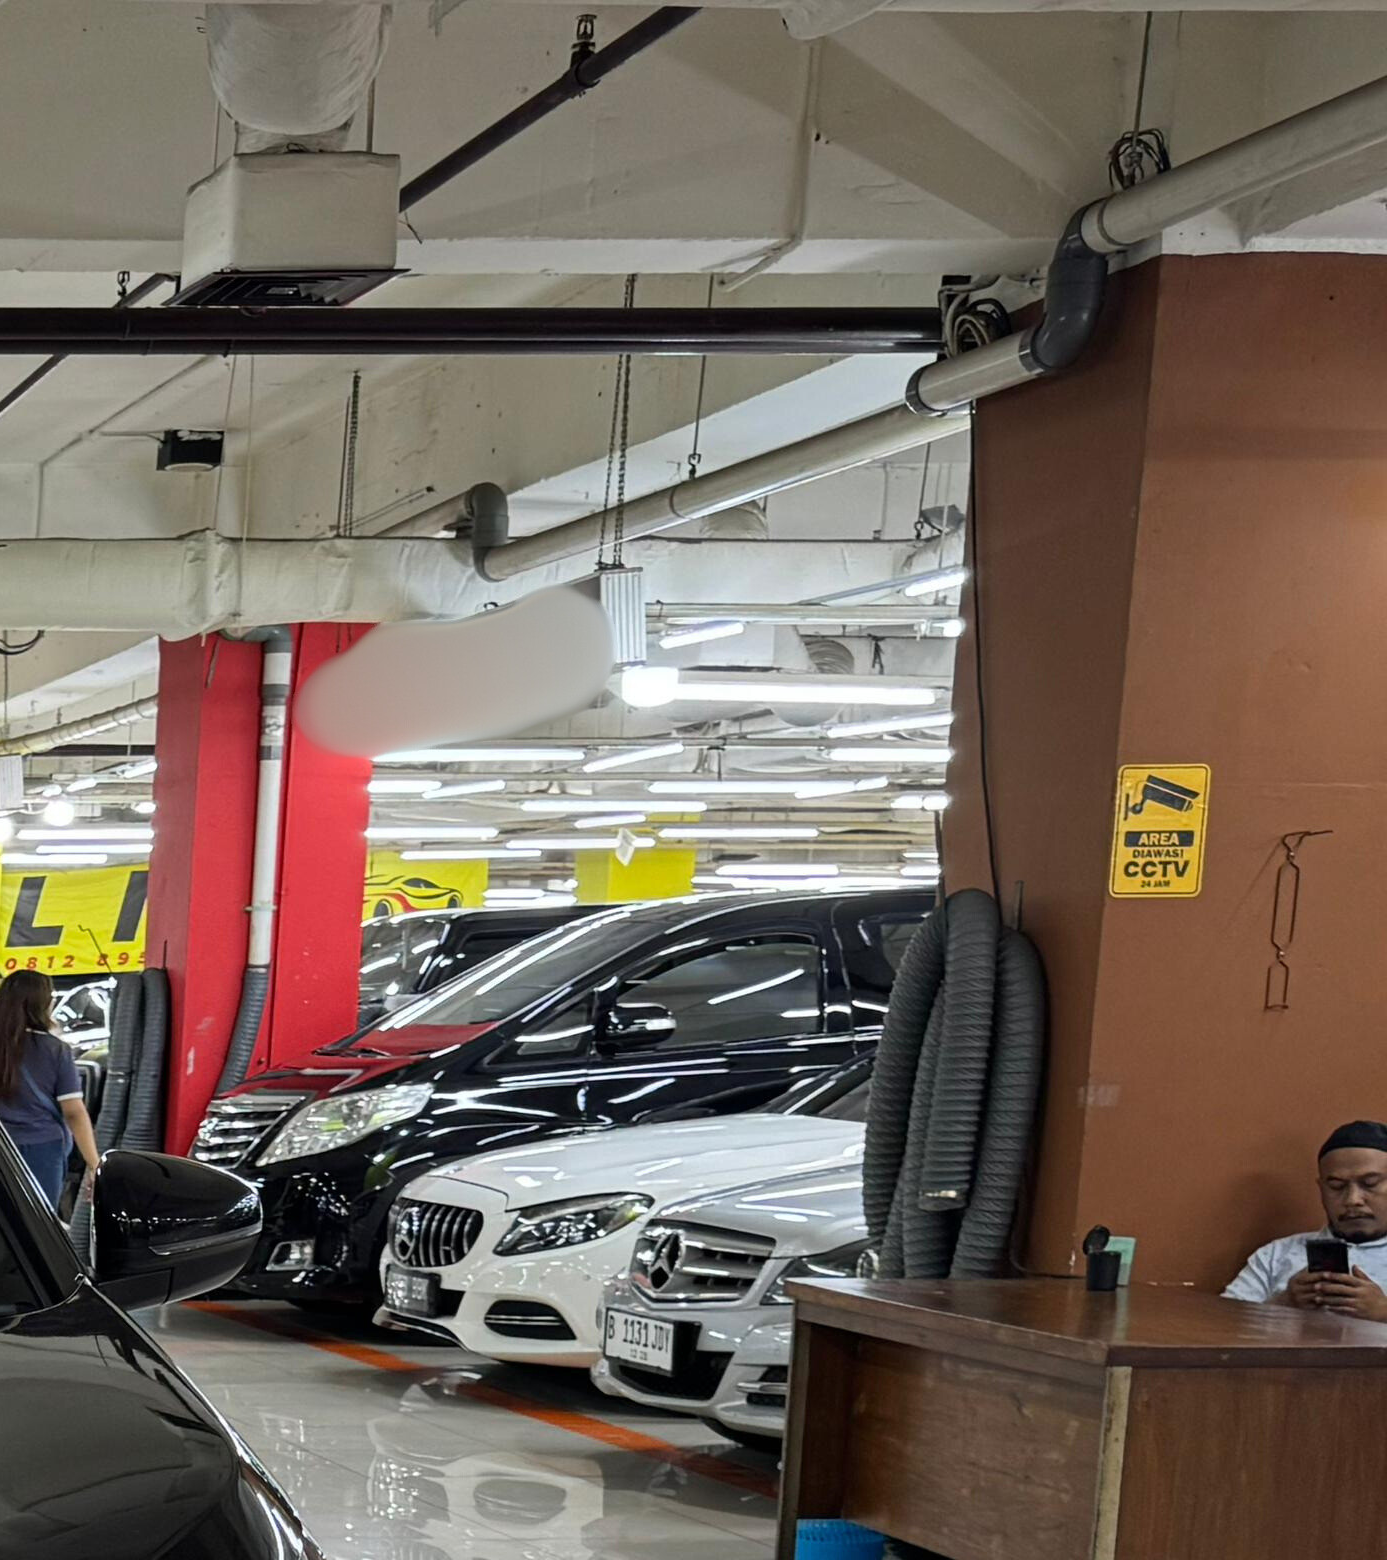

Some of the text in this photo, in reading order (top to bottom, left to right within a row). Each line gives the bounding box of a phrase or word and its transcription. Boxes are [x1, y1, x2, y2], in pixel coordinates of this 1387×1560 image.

[1138, 833, 1180, 845] AREA
[1132, 849, 1184, 858] DIAWASI
[1123, 860, 1190, 877] CCTV
[5, 955, 75, 970] 0812
[608, 1314, 615, 1339] B
[623, 1318, 649, 1347] 1131
